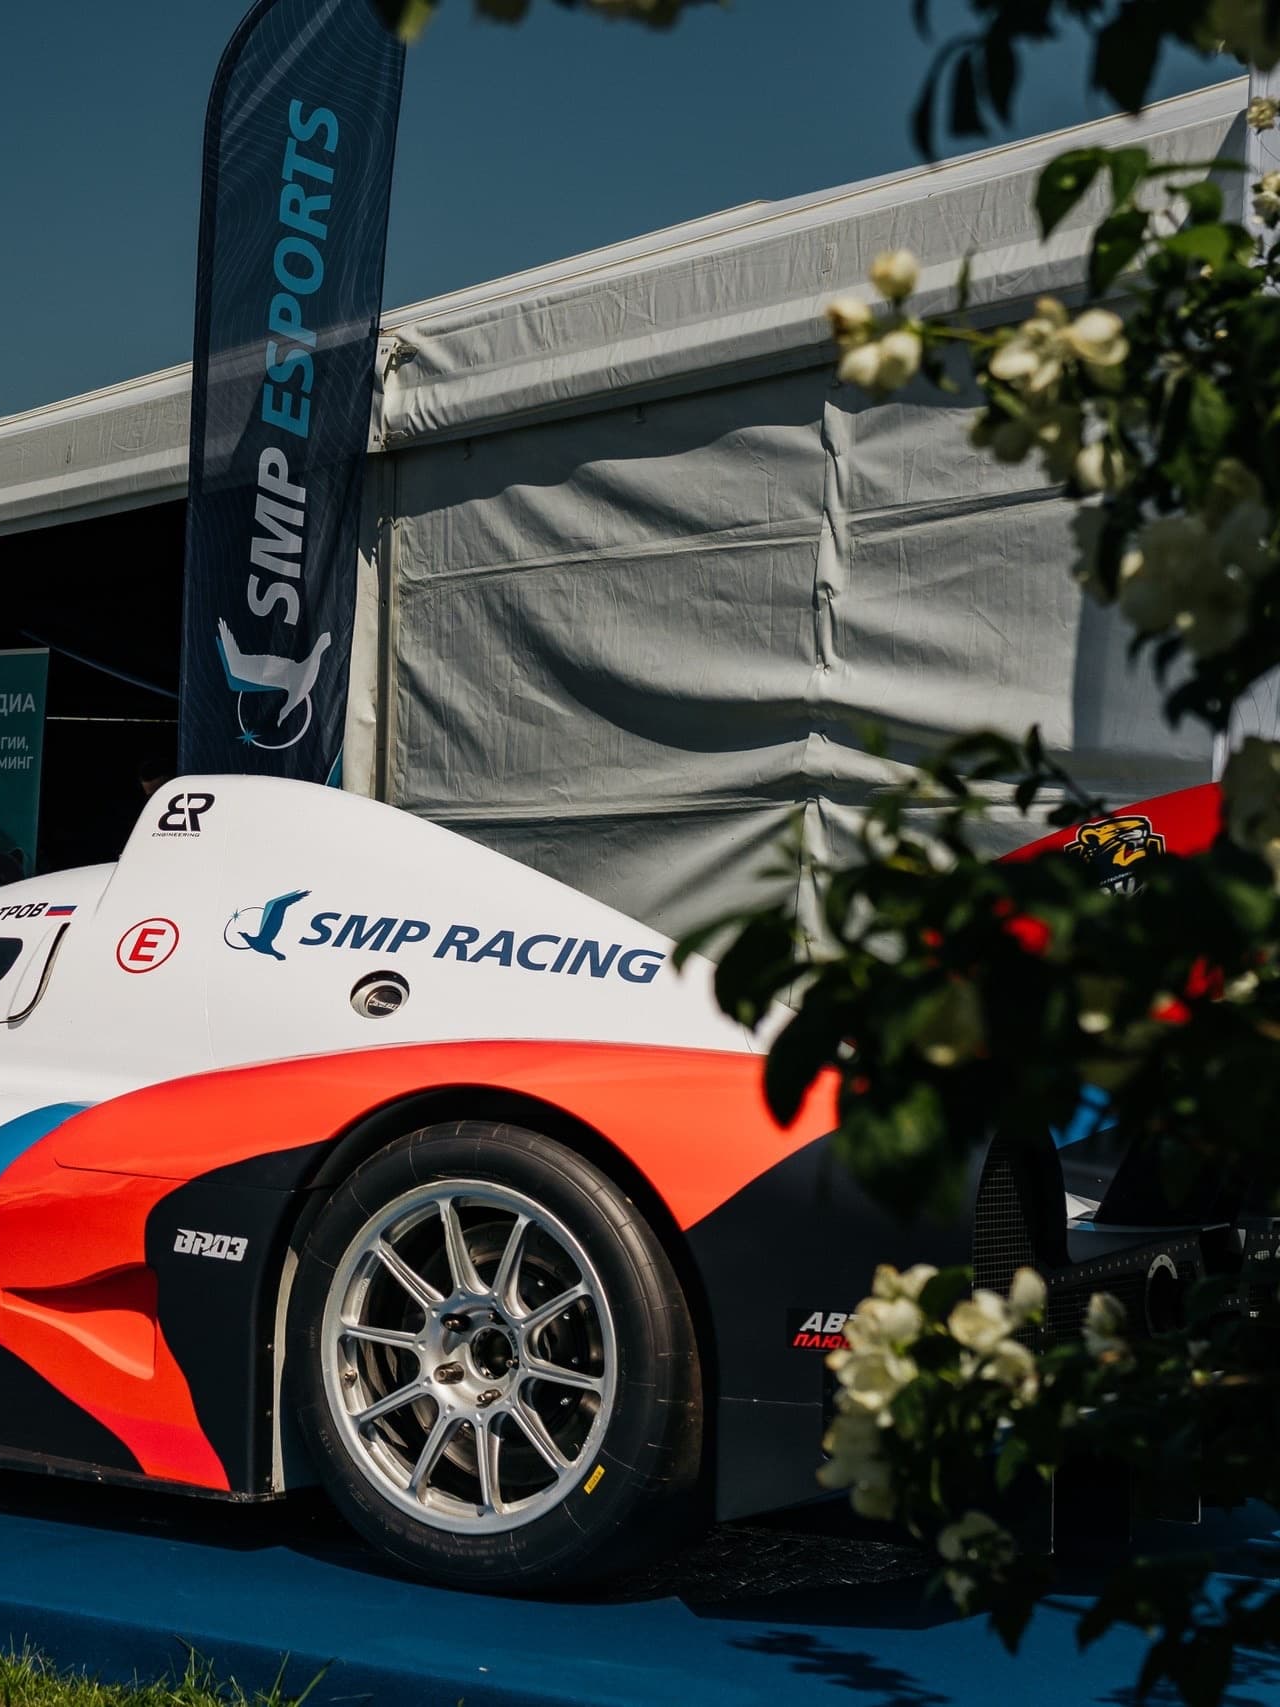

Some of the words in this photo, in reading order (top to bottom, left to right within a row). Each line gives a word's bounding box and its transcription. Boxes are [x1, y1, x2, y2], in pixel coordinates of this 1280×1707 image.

[261, 98, 339, 439] ESPORTS
[247, 446, 306, 625] SMP
[128, 928, 166, 962] E
[298, 911, 431, 953] SMP
[433, 924, 666, 984] RACING
